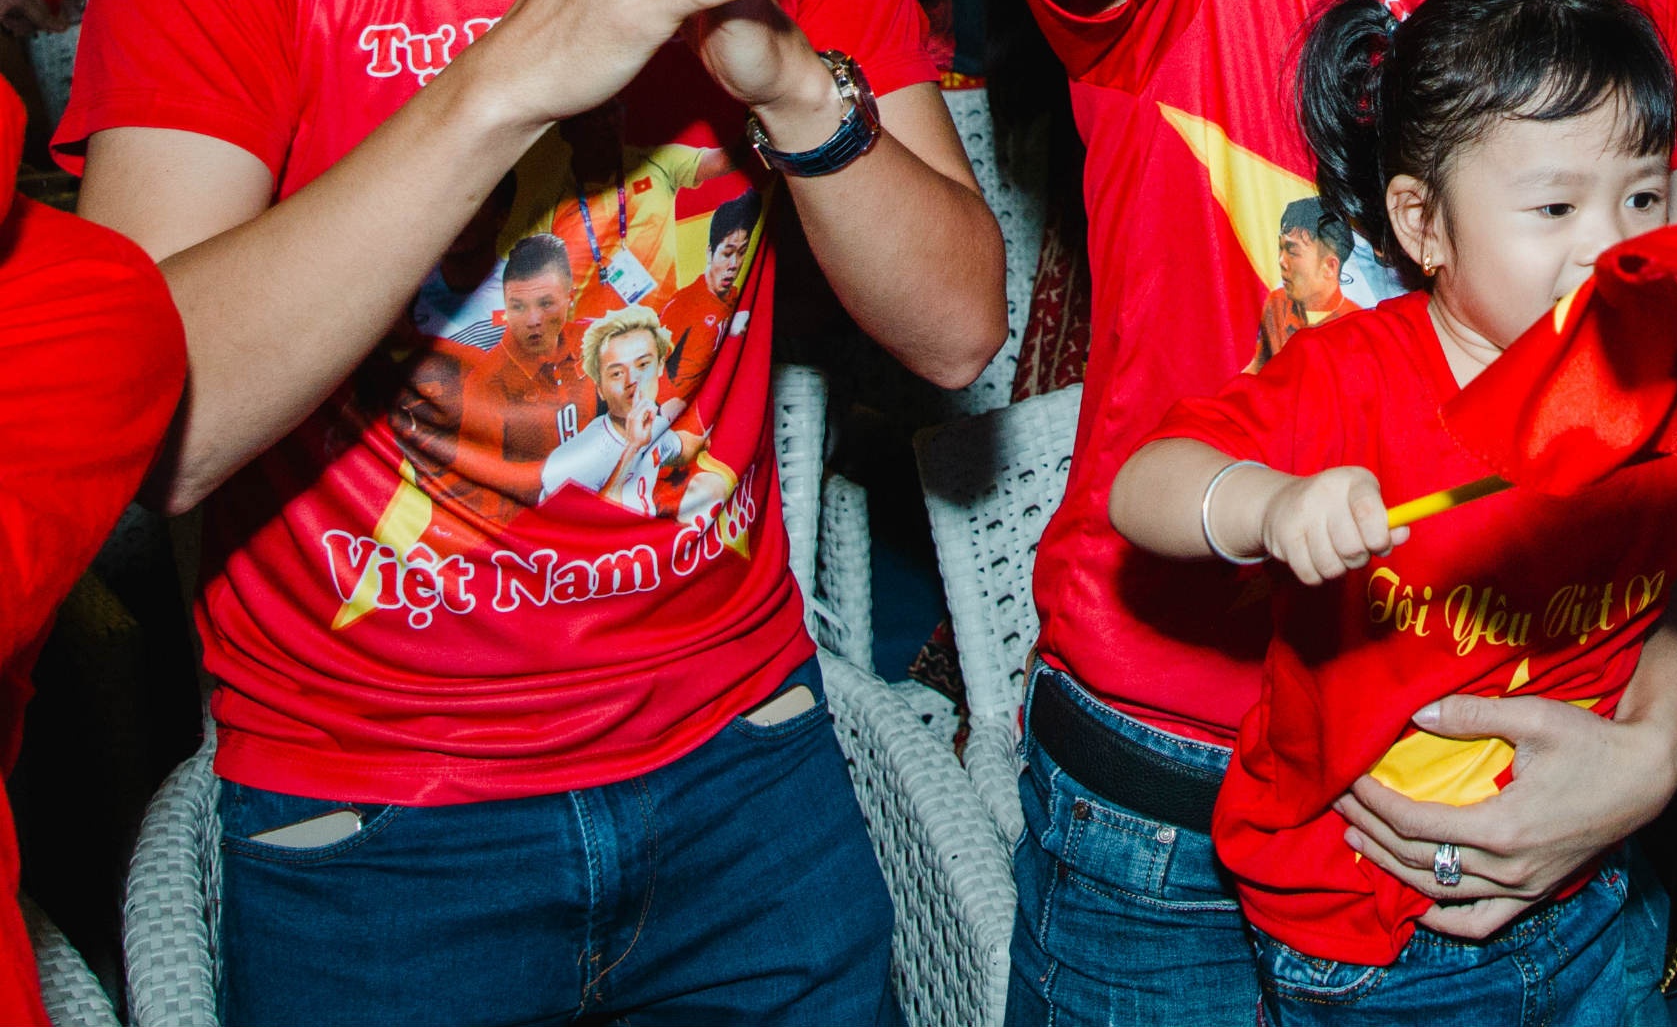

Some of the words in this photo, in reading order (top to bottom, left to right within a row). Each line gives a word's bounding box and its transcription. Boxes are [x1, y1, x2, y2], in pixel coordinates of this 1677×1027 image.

[321, 528, 477, 630] Việt
[490, 543, 661, 613] Nam
[1367, 566, 1432, 637] Tôi
[1444, 583, 1534, 657] Yêu
